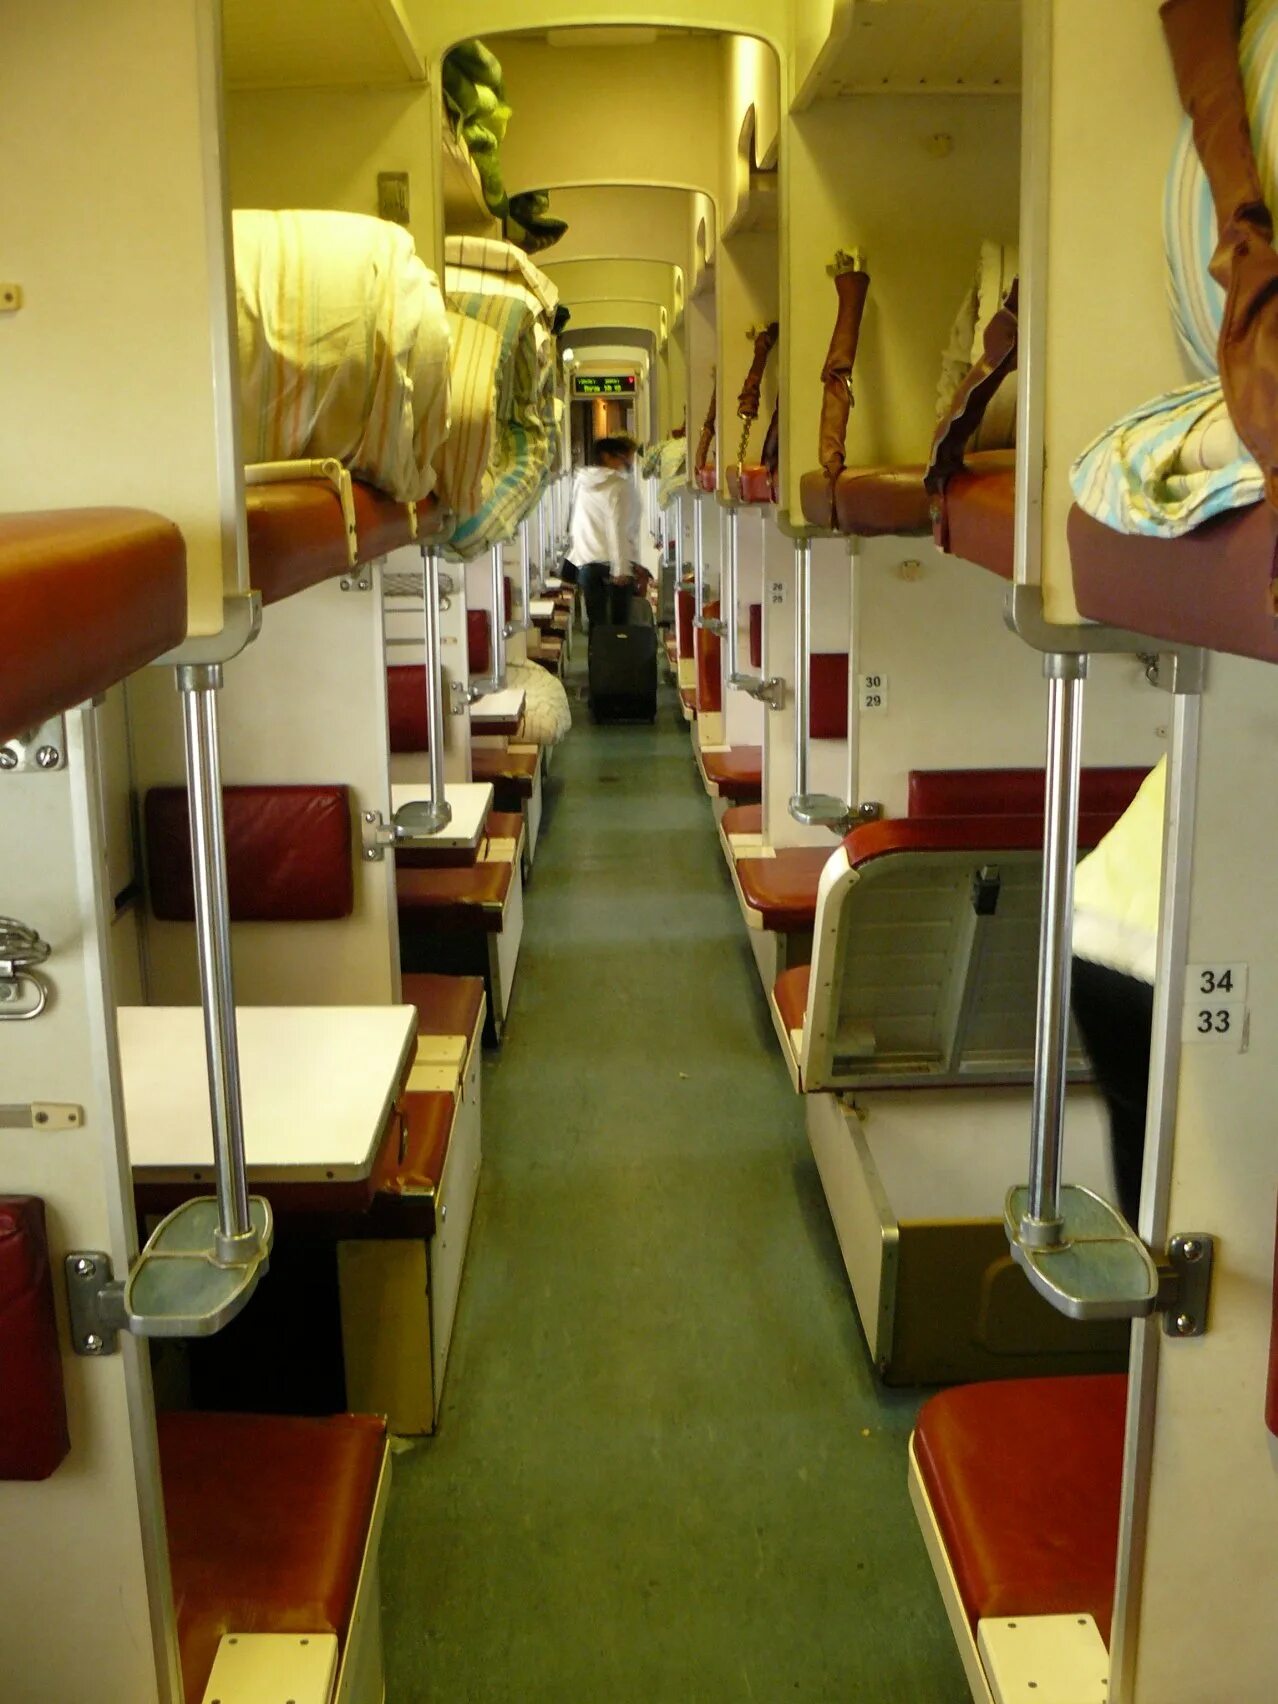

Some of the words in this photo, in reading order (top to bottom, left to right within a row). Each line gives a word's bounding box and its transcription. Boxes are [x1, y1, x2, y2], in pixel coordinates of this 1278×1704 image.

[866, 676, 881, 688] 30
[866, 695, 881, 707] 29
[1200, 969, 1234, 994] 34
[1198, 1010, 1230, 1034] 33
